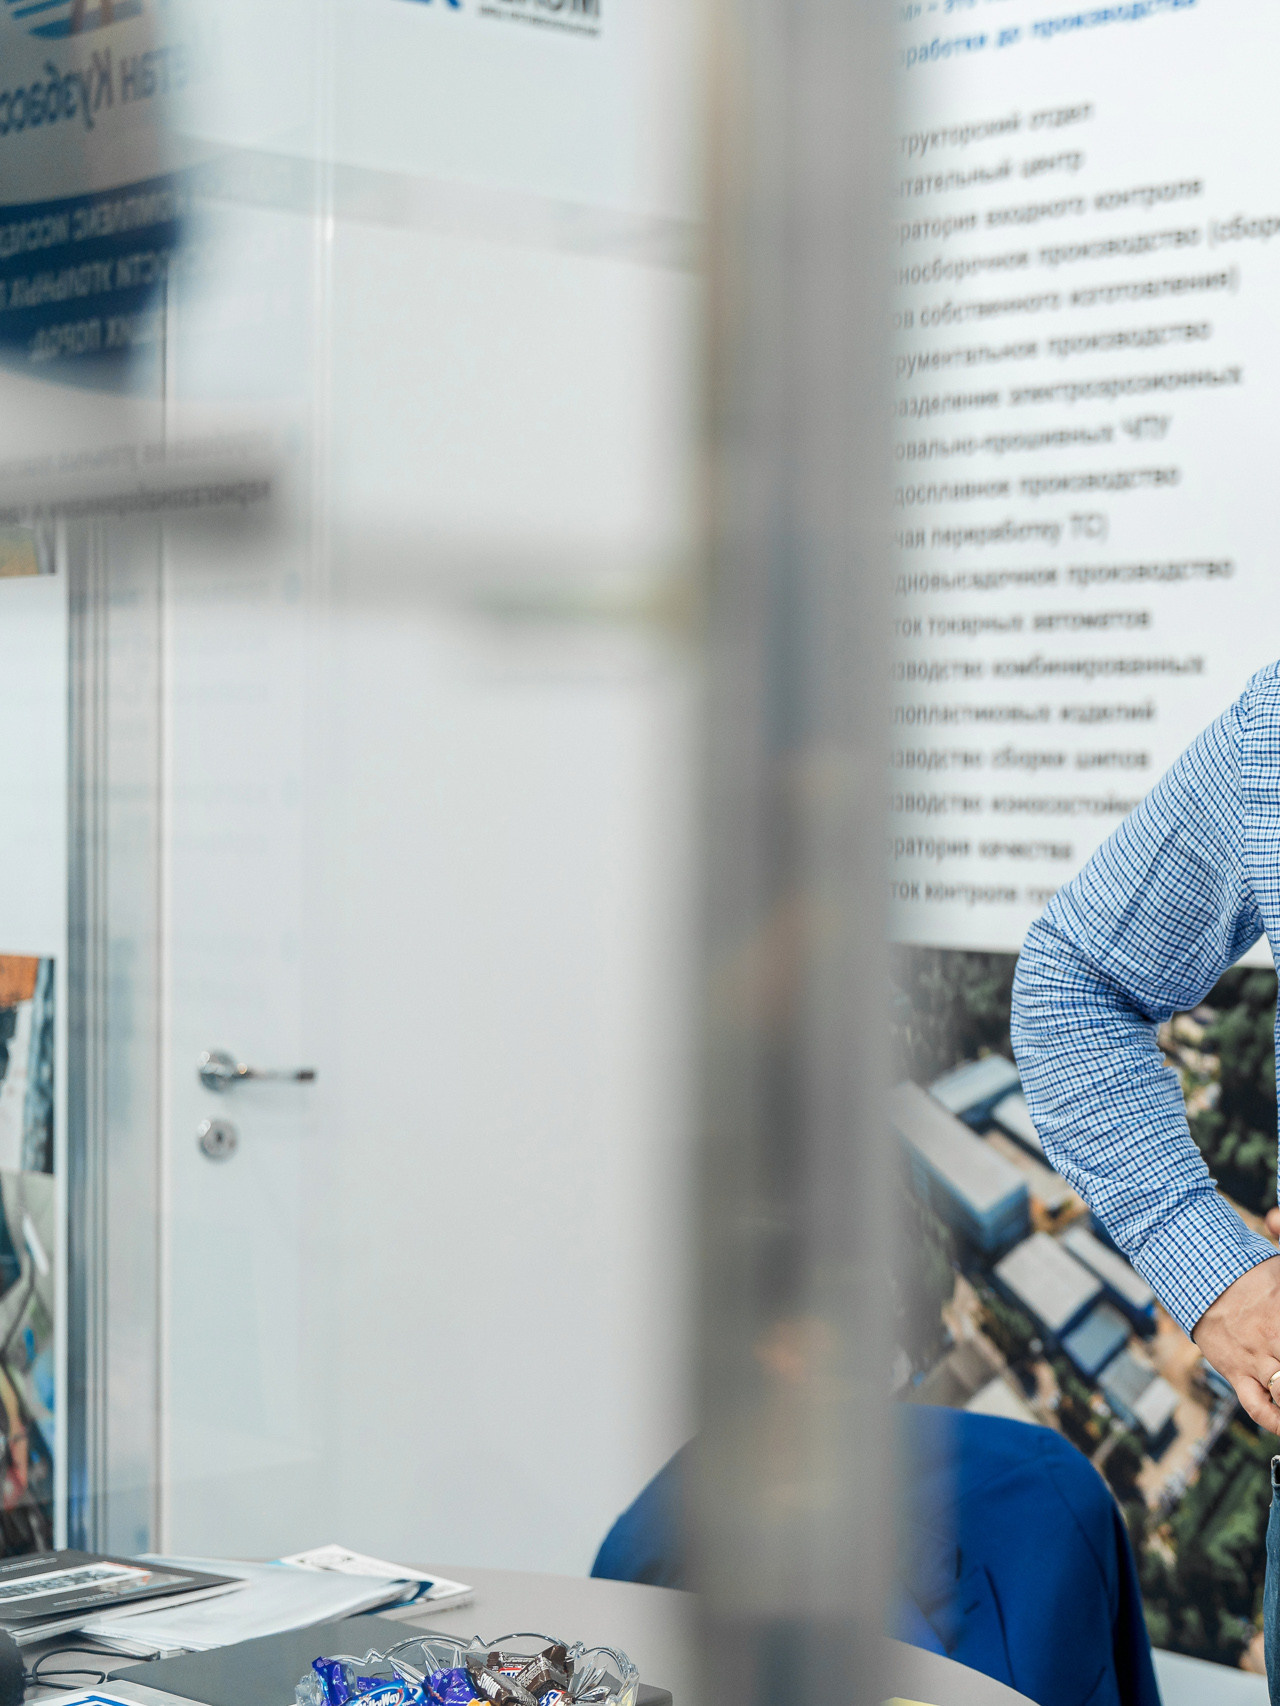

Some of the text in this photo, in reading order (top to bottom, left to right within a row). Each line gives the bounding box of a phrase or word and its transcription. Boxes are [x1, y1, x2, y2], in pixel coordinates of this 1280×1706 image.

[903, 34, 987, 68] работки
[996, 27, 1021, 48] до
[901, 100, 1093, 157] трукторский отдел
[901, 149, 1085, 198] тательный центр
[899, 177, 1204, 245] ратория входного контроля
[898, 250, 1029, 287] носборочное
[1038, 226, 1201, 269] производство
[919, 292, 1061, 328] собственного
[1069, 263, 1239, 307] изготовления)
[895, 319, 1212, 378] рументальное производство
[892, 388, 999, 418] азделение
[895, 413, 1172, 462] овально-прошивных ЧПУ
[895, 464, 1181, 508] досплавное производство
[931, 516, 1064, 550] переработку
[895, 558, 1234, 597] дновысадочное производство
[928, 612, 1023, 641] токарных
[1032, 606, 1152, 632] автоматов
[894, 650, 1206, 684] зводство комбинированных
[1058, 697, 1156, 725] изделий
[893, 740, 1152, 775] зводство сборки шипов
[893, 792, 982, 817] зводство
[895, 836, 1074, 863] ратория качества
[925, 881, 1017, 907] контроля
